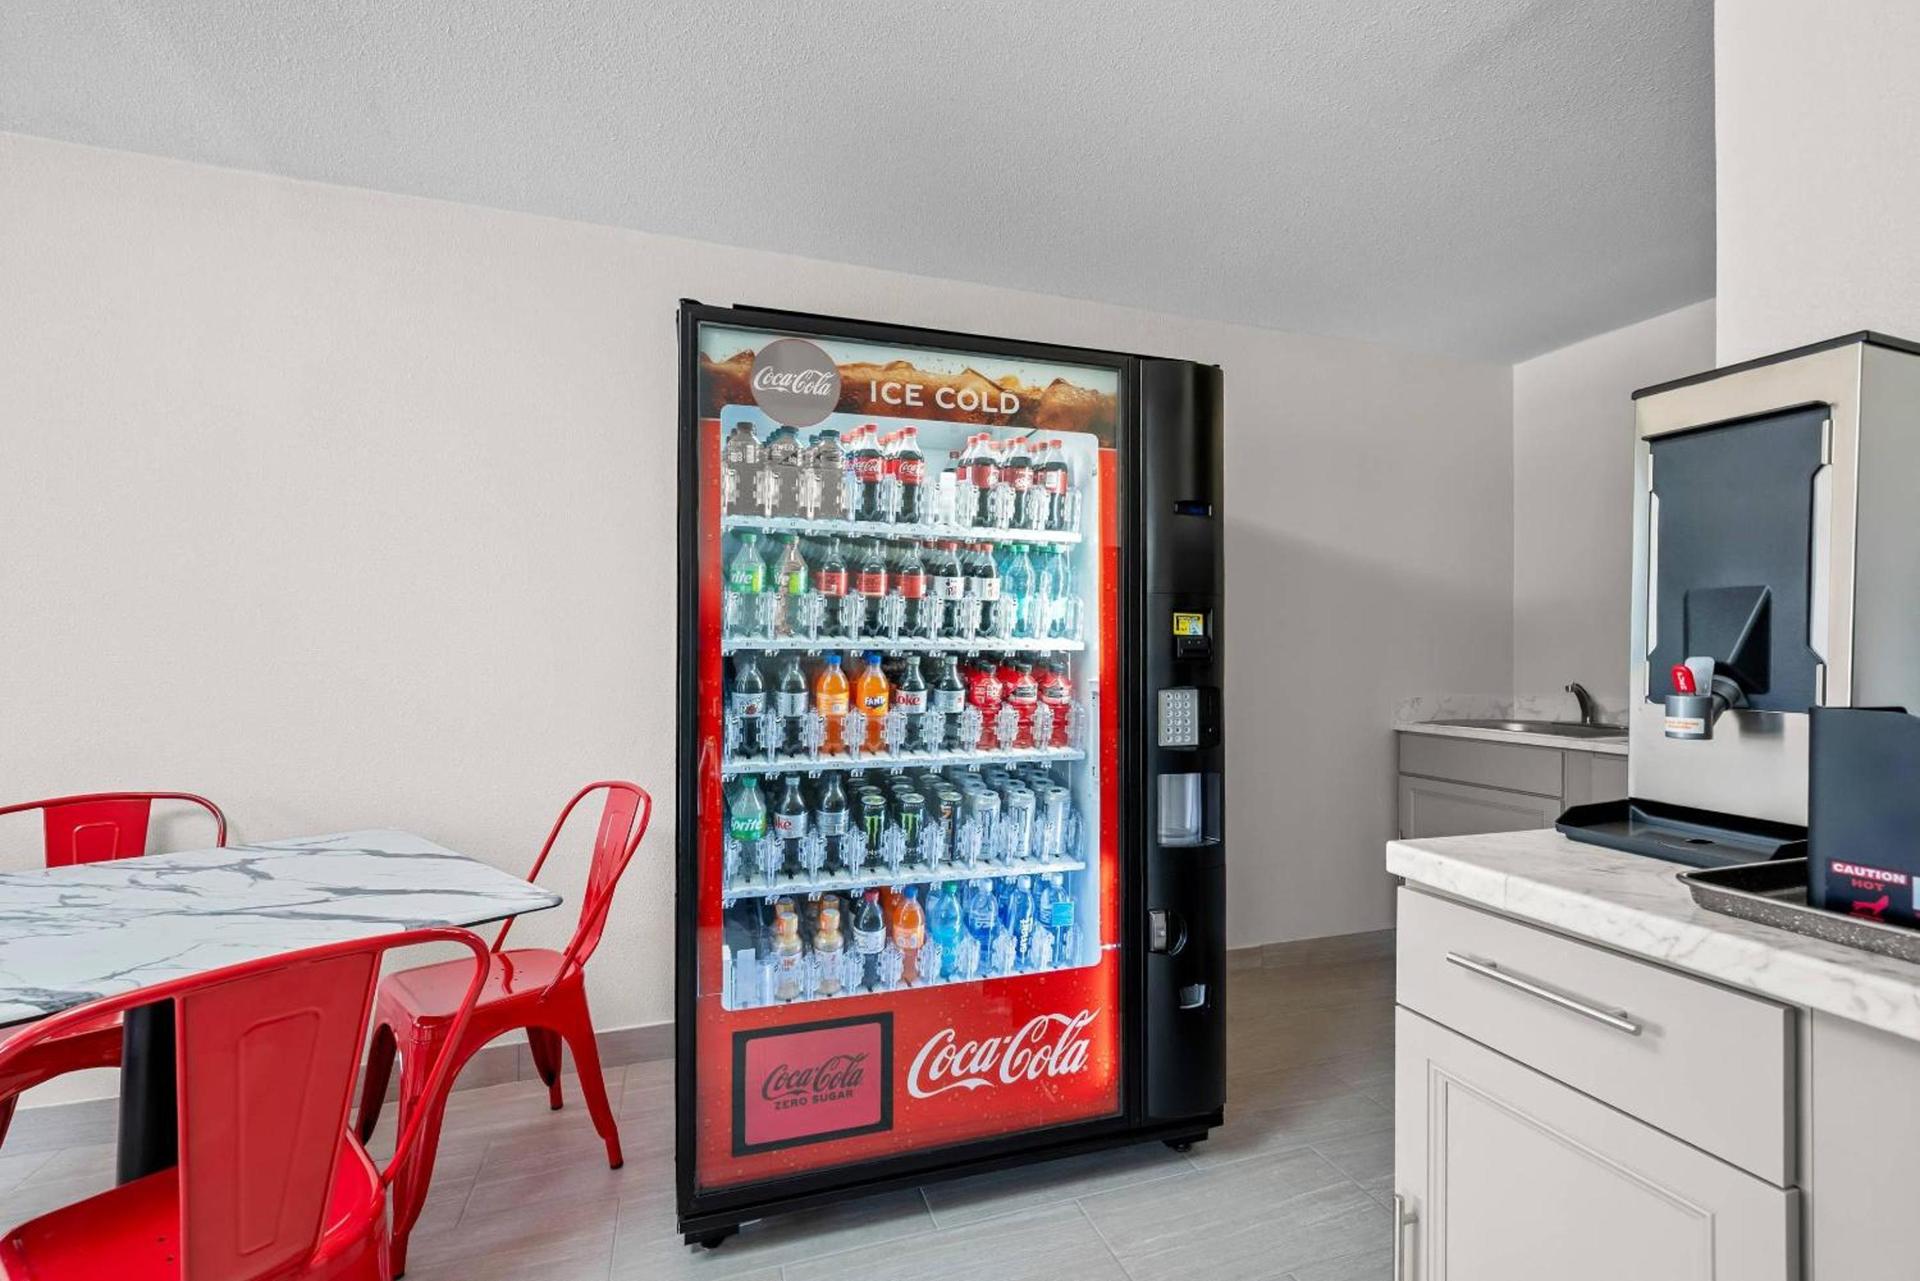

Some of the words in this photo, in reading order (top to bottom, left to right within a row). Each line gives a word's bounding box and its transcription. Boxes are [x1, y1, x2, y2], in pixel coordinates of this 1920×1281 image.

[753, 366, 834, 396] Coca-Cola
[870, 380, 924, 407] ICE
[935, 387, 1020, 414] COLD
[1831, 862, 1907, 885] CAUTION
[1852, 878, 1885, 891] HOT
[907, 1007, 1101, 1099] Coca-Cola
[762, 1052, 869, 1101] Coca-Cola
[774, 1097, 808, 1110] ZERO
[812, 1090, 854, 1105] SUGAR
